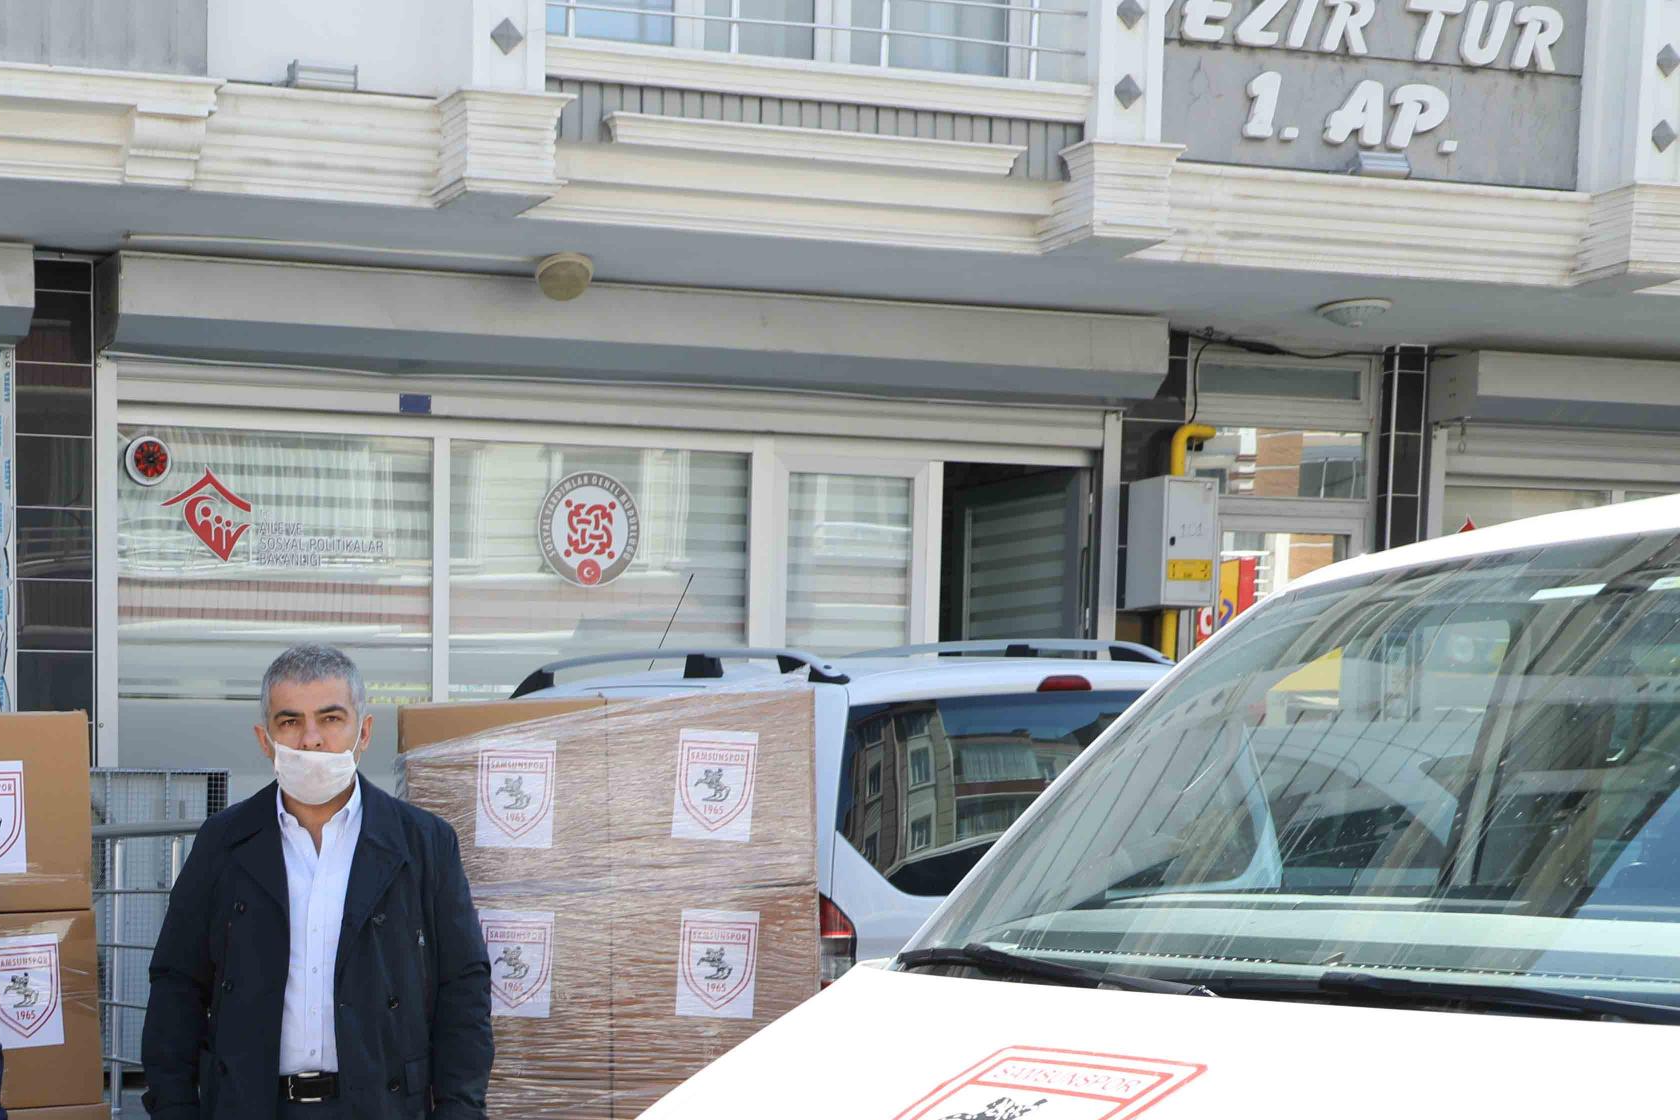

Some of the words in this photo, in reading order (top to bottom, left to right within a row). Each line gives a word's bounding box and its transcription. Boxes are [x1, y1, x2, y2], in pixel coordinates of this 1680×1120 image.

[1165, 0, 1377, 56] EZIR
[1406, 0, 1564, 73] TUR
[1241, 70, 1300, 142] 1.
[1322, 79, 1459, 156] AP.
[259, 537, 305, 551] SOSYAL
[690, 751, 746, 762] SAMSUNSPOR
[490, 759, 545, 771] SAMSUNSPOR
[703, 804, 724, 815] 1965
[489, 930, 544, 942] SAMSUNSPOR
[503, 982, 524, 993] 1965
[706, 982, 727, 993] 1965
[15, 1009, 37, 1021] 1965
[993, 1064, 1142, 1095] SAMSUNSPOR
